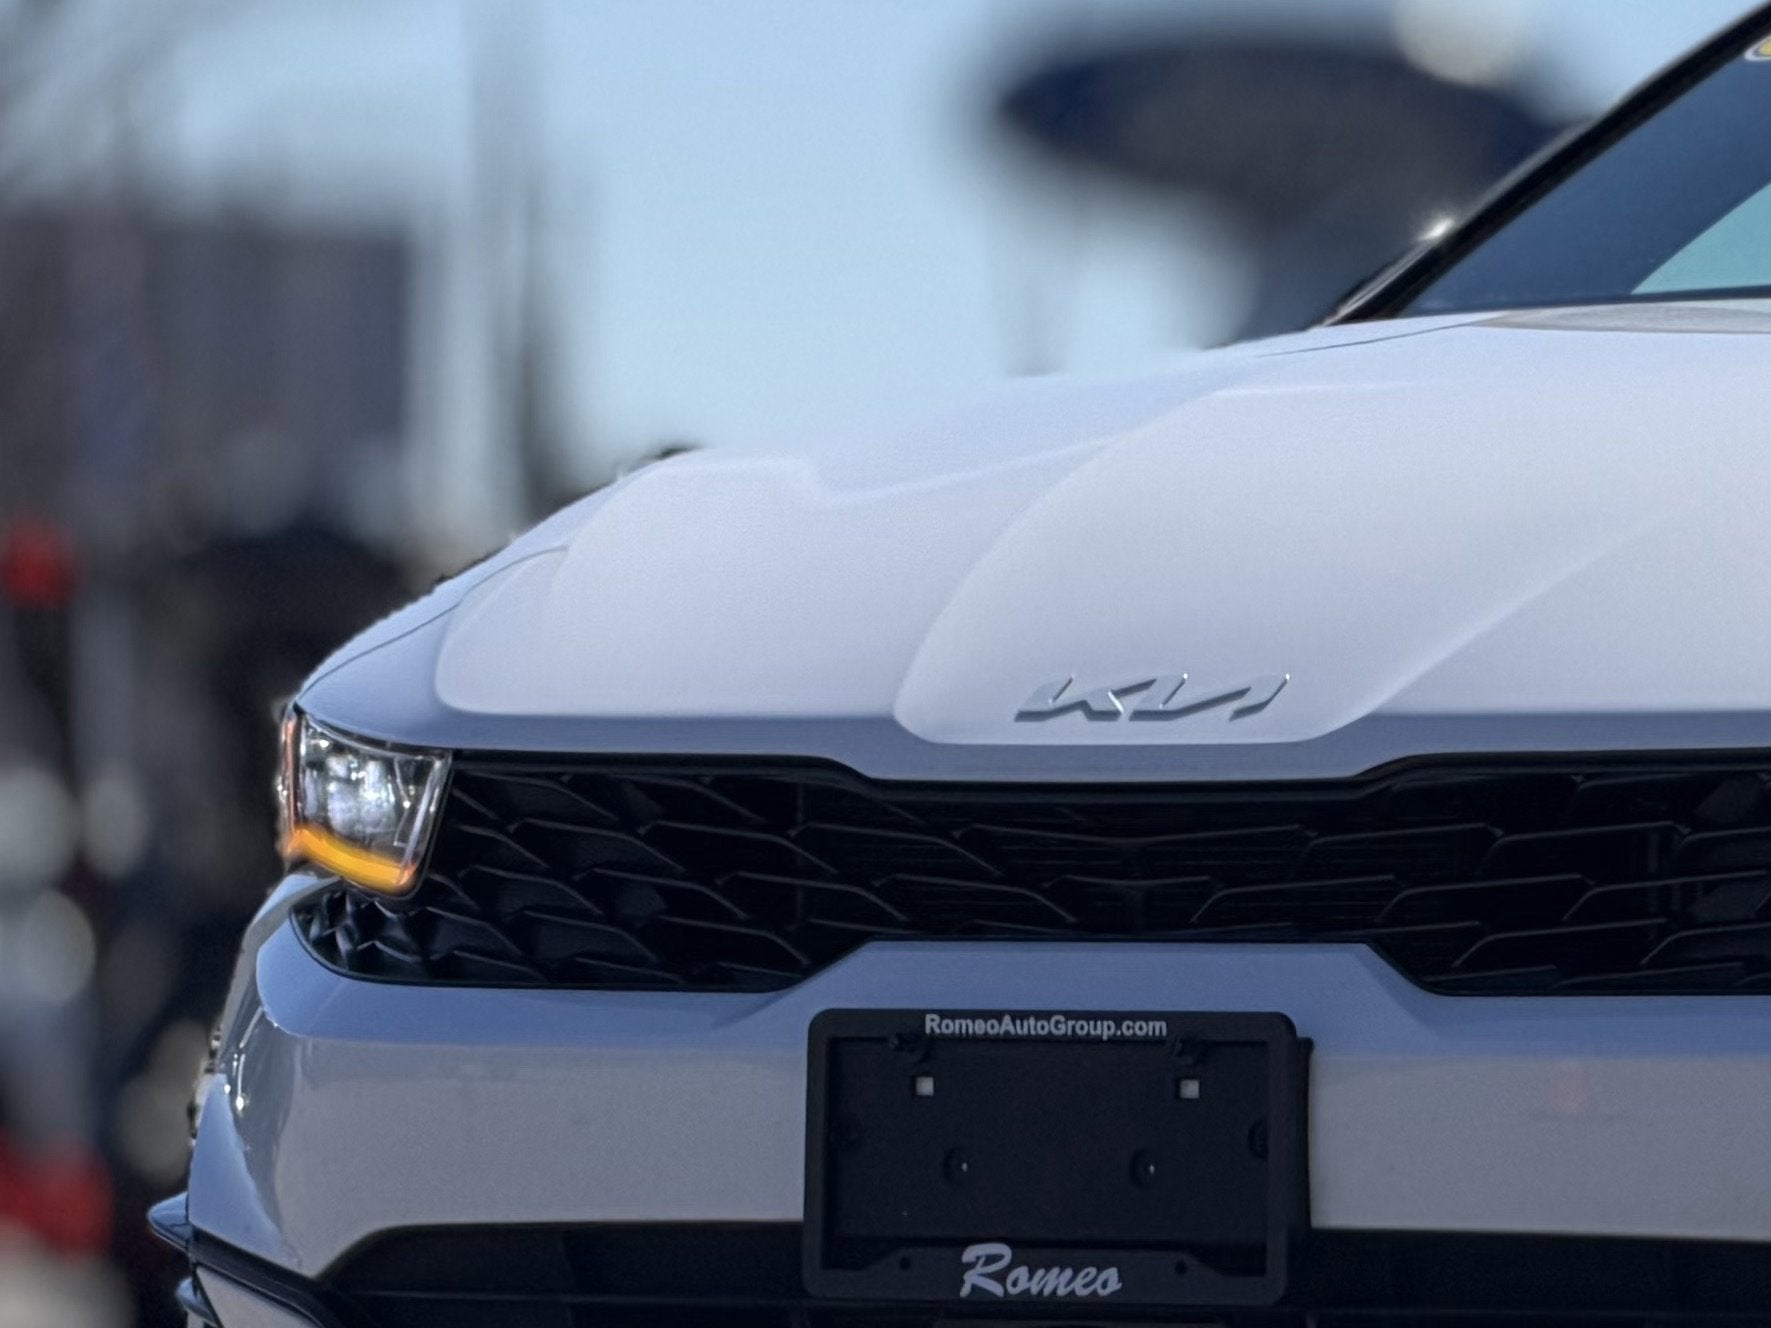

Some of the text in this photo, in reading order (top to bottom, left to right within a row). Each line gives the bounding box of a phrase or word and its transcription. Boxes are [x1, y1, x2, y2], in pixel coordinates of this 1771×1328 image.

[1013, 673, 1291, 723] KIA
[924, 1013, 1168, 1040] RomeoAutoGroup.com
[959, 1242, 1123, 1298] Romeo
